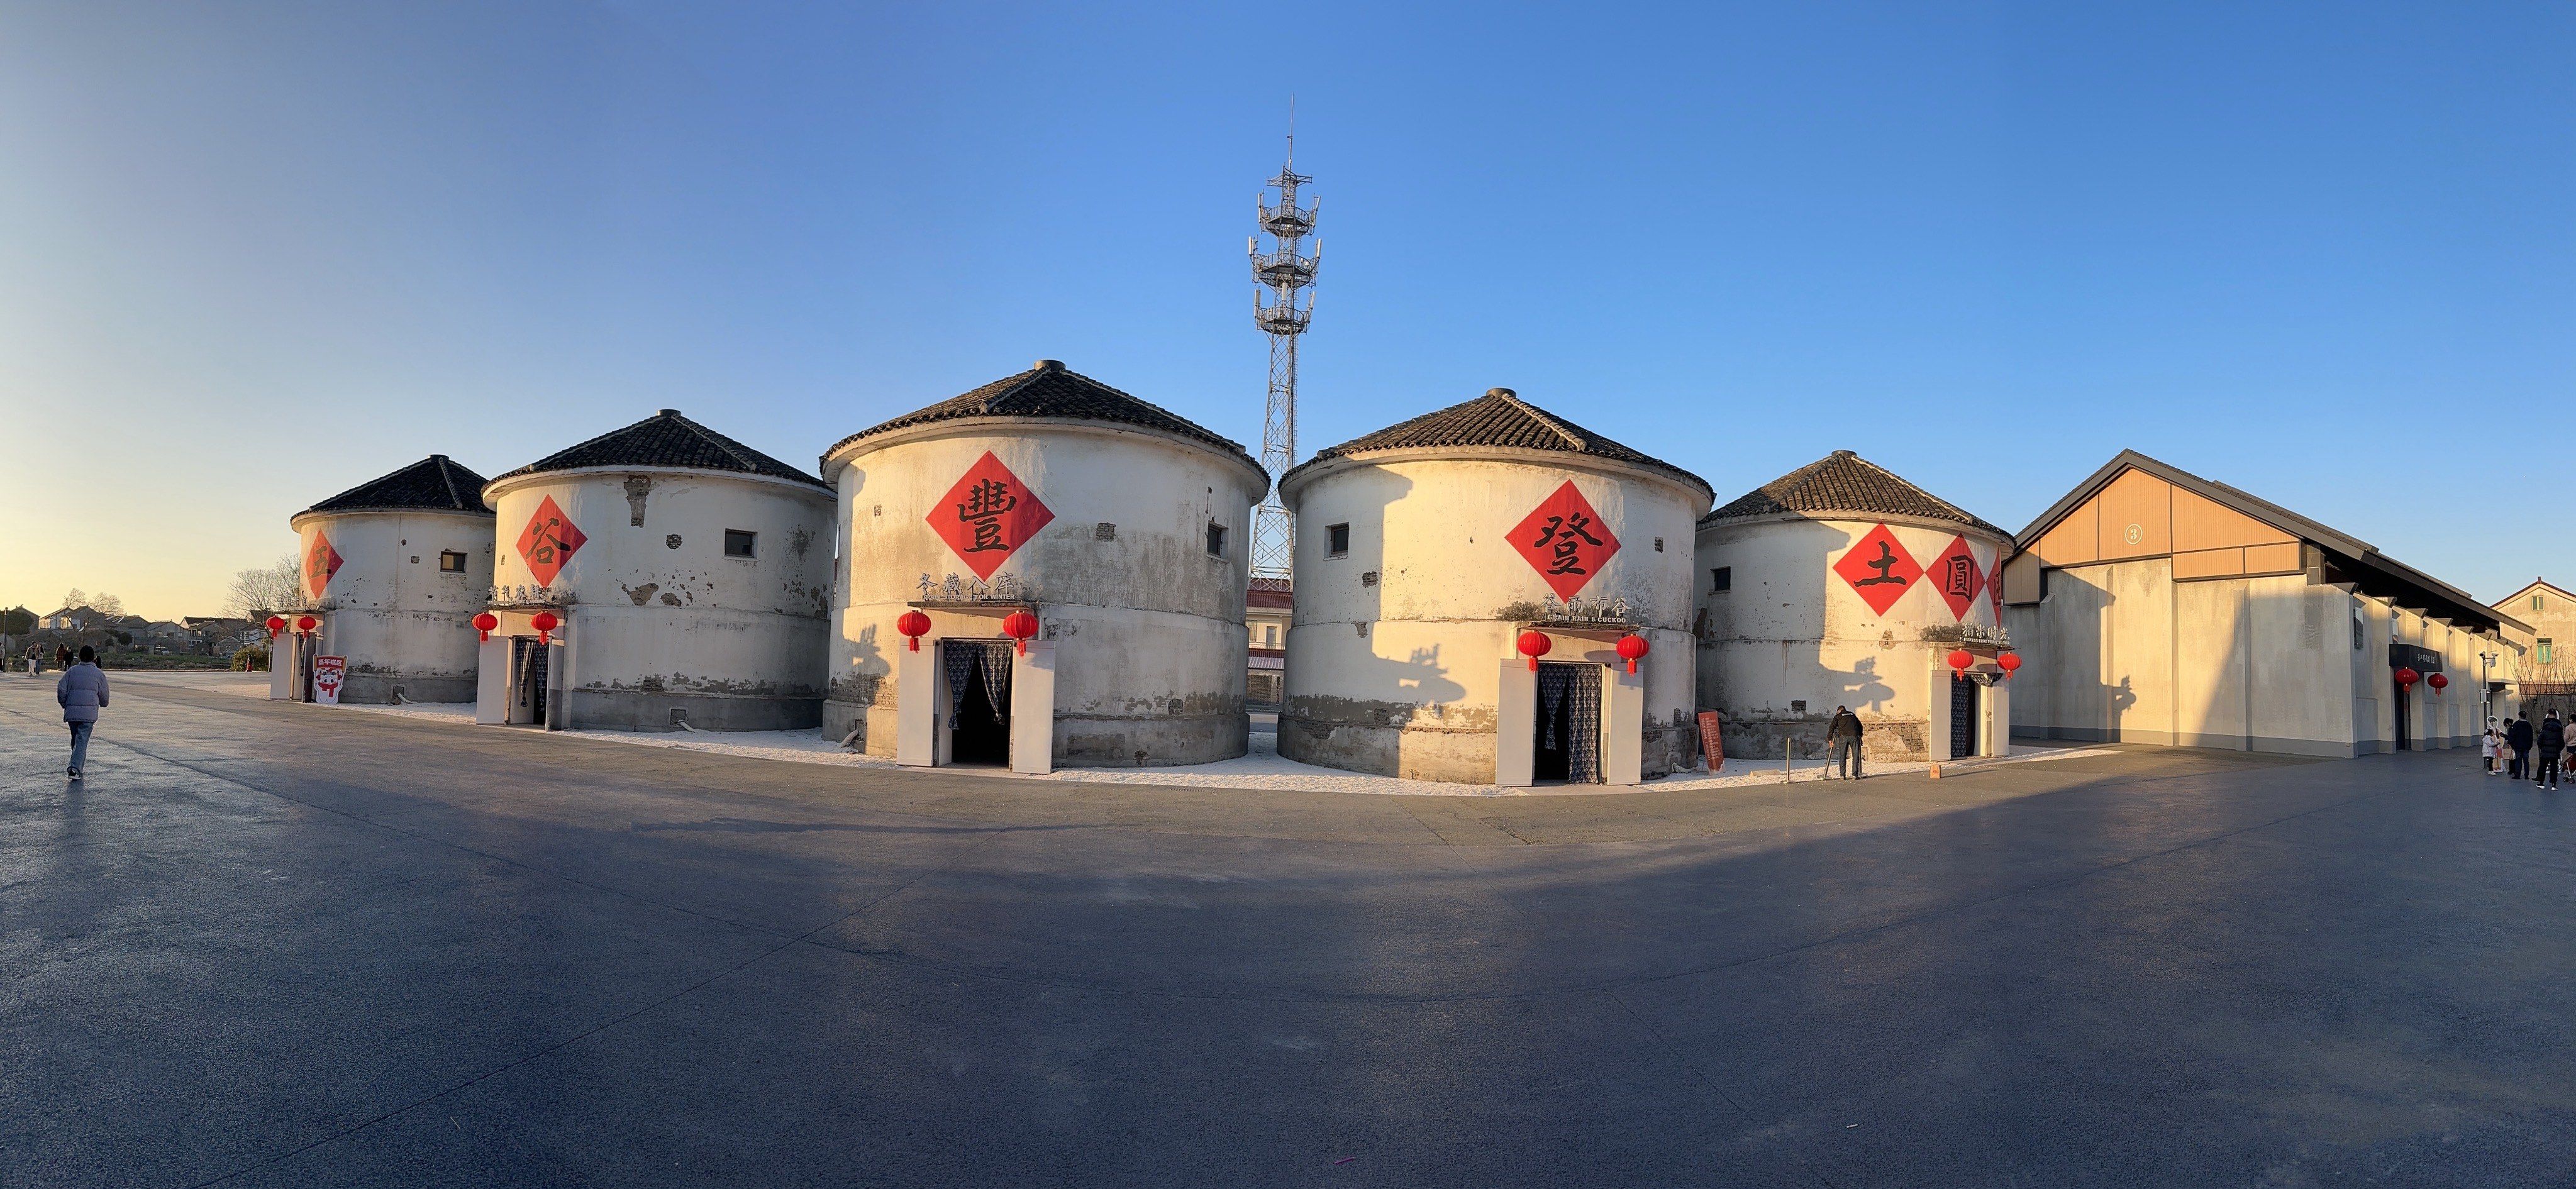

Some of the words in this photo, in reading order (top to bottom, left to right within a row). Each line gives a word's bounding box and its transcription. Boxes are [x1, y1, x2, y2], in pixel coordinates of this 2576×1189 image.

[957, 478, 1017, 553] 豐
[526, 517, 571, 564] 谷
[1534, 512, 1604, 575] 登
[309, 545, 332, 579] 五
[1853, 540, 1907, 587] 土
[916, 571, 1014, 597] 冬藏仓库
[1541, 592, 1632, 617] 谷雨布谷
[1962, 622, 2011, 640] 稻米时光
